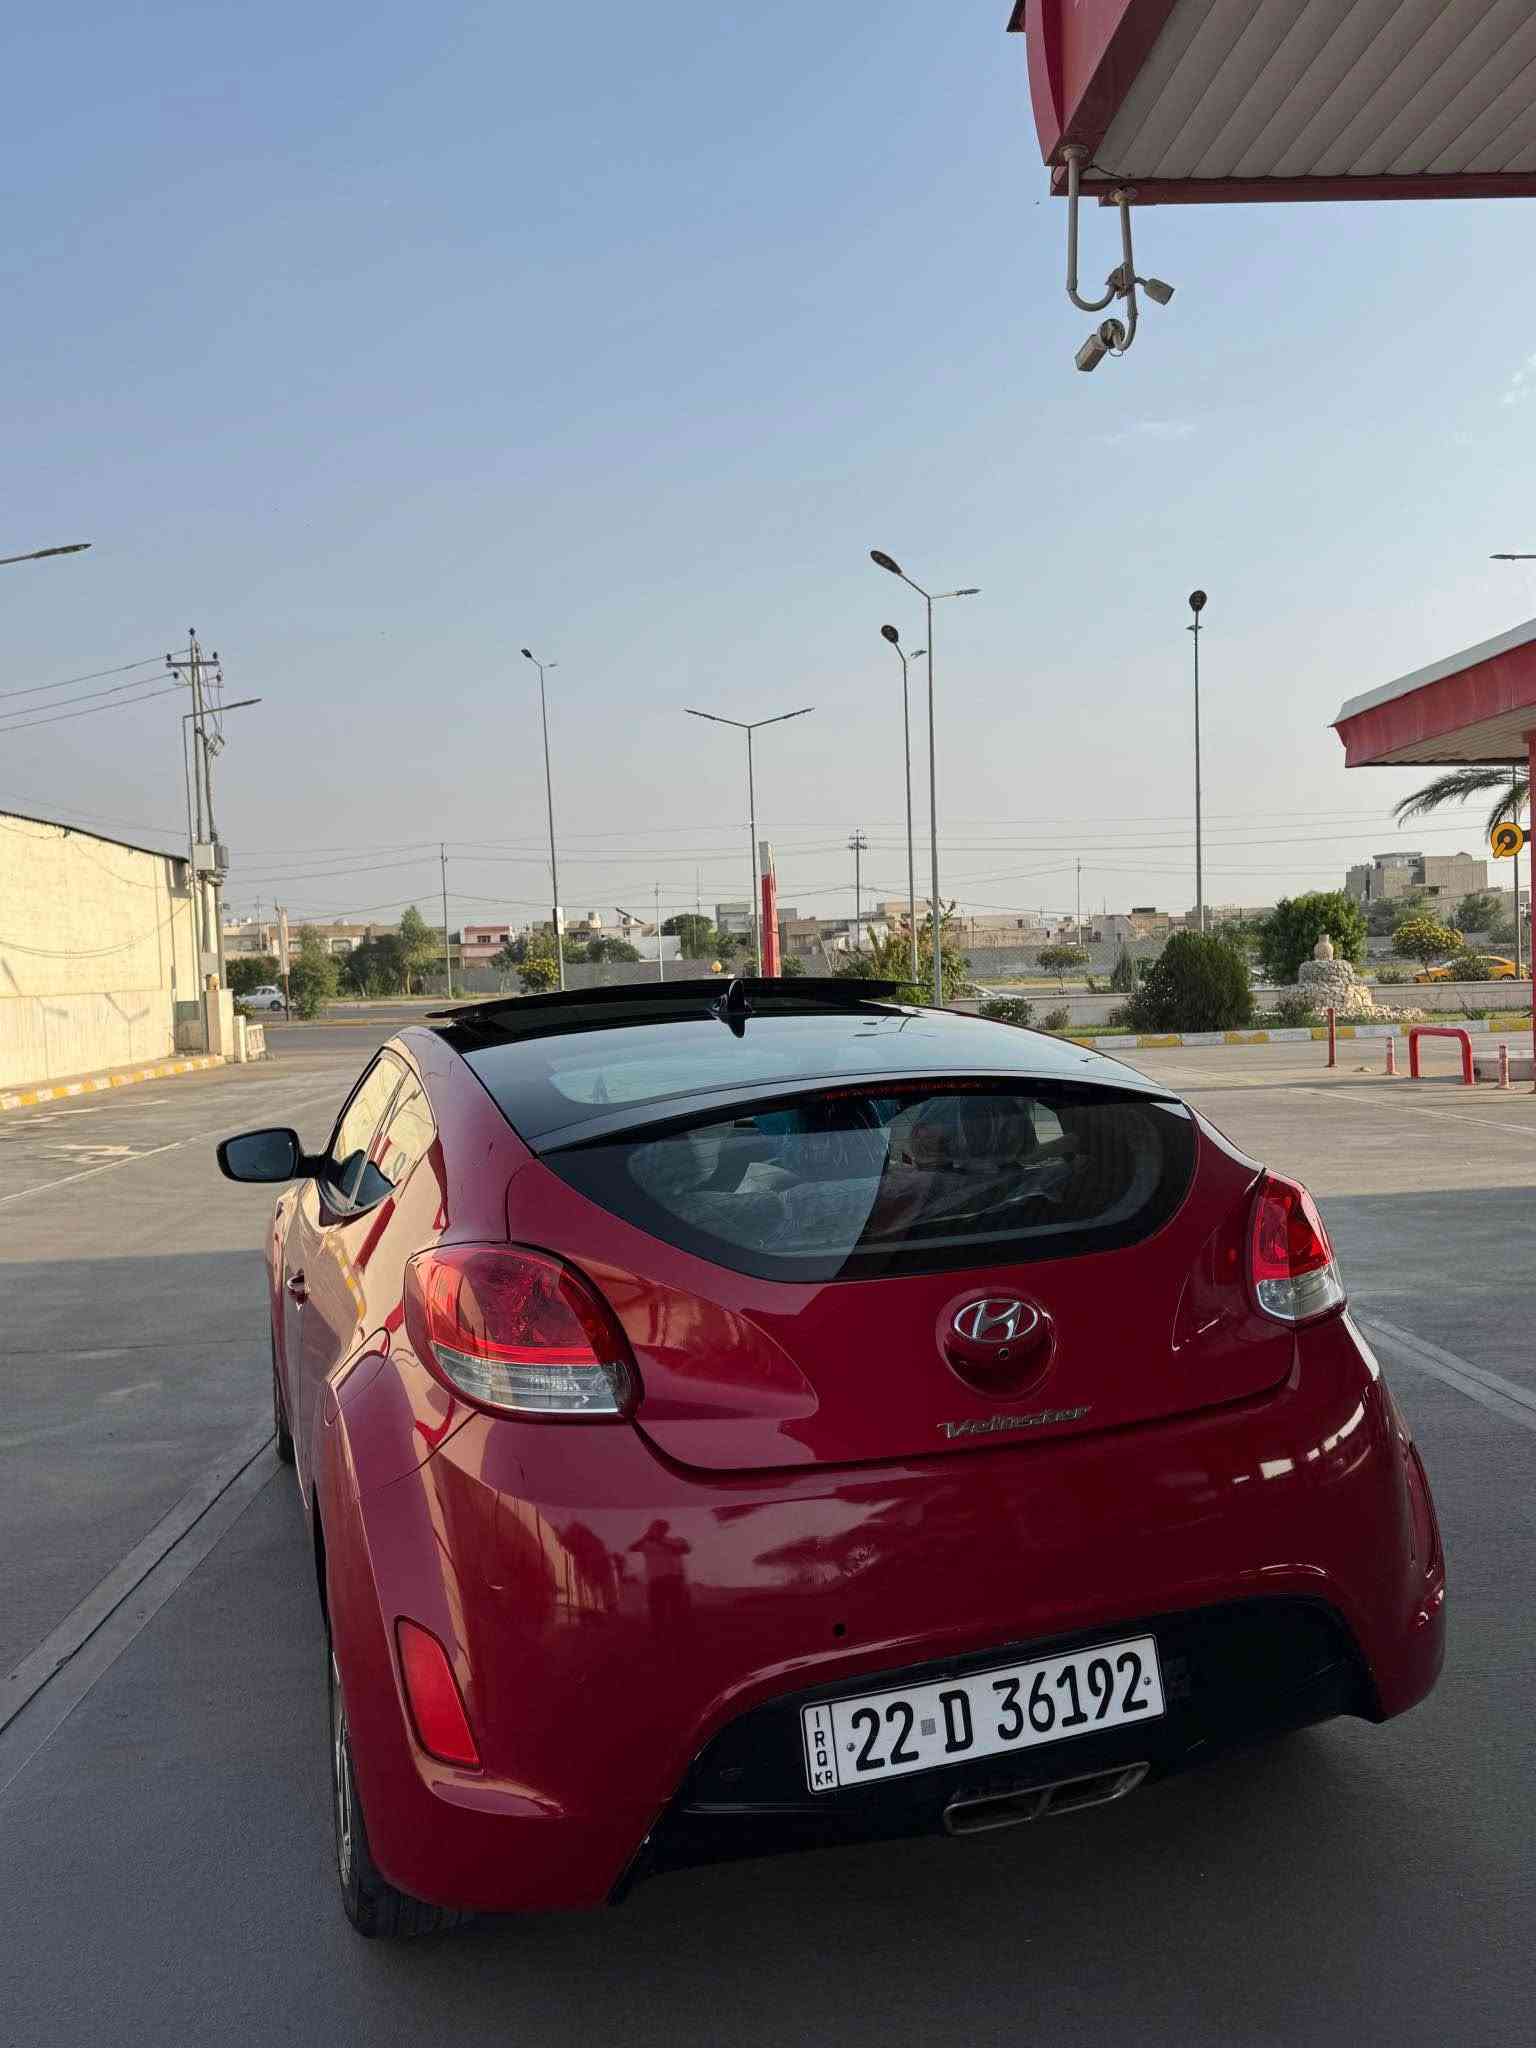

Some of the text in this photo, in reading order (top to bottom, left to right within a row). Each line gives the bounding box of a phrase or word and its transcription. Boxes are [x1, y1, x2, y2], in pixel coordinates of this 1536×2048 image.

[851, 1651, 1148, 1771] 22 D 36192
[814, 1770, 834, 1786] KR
